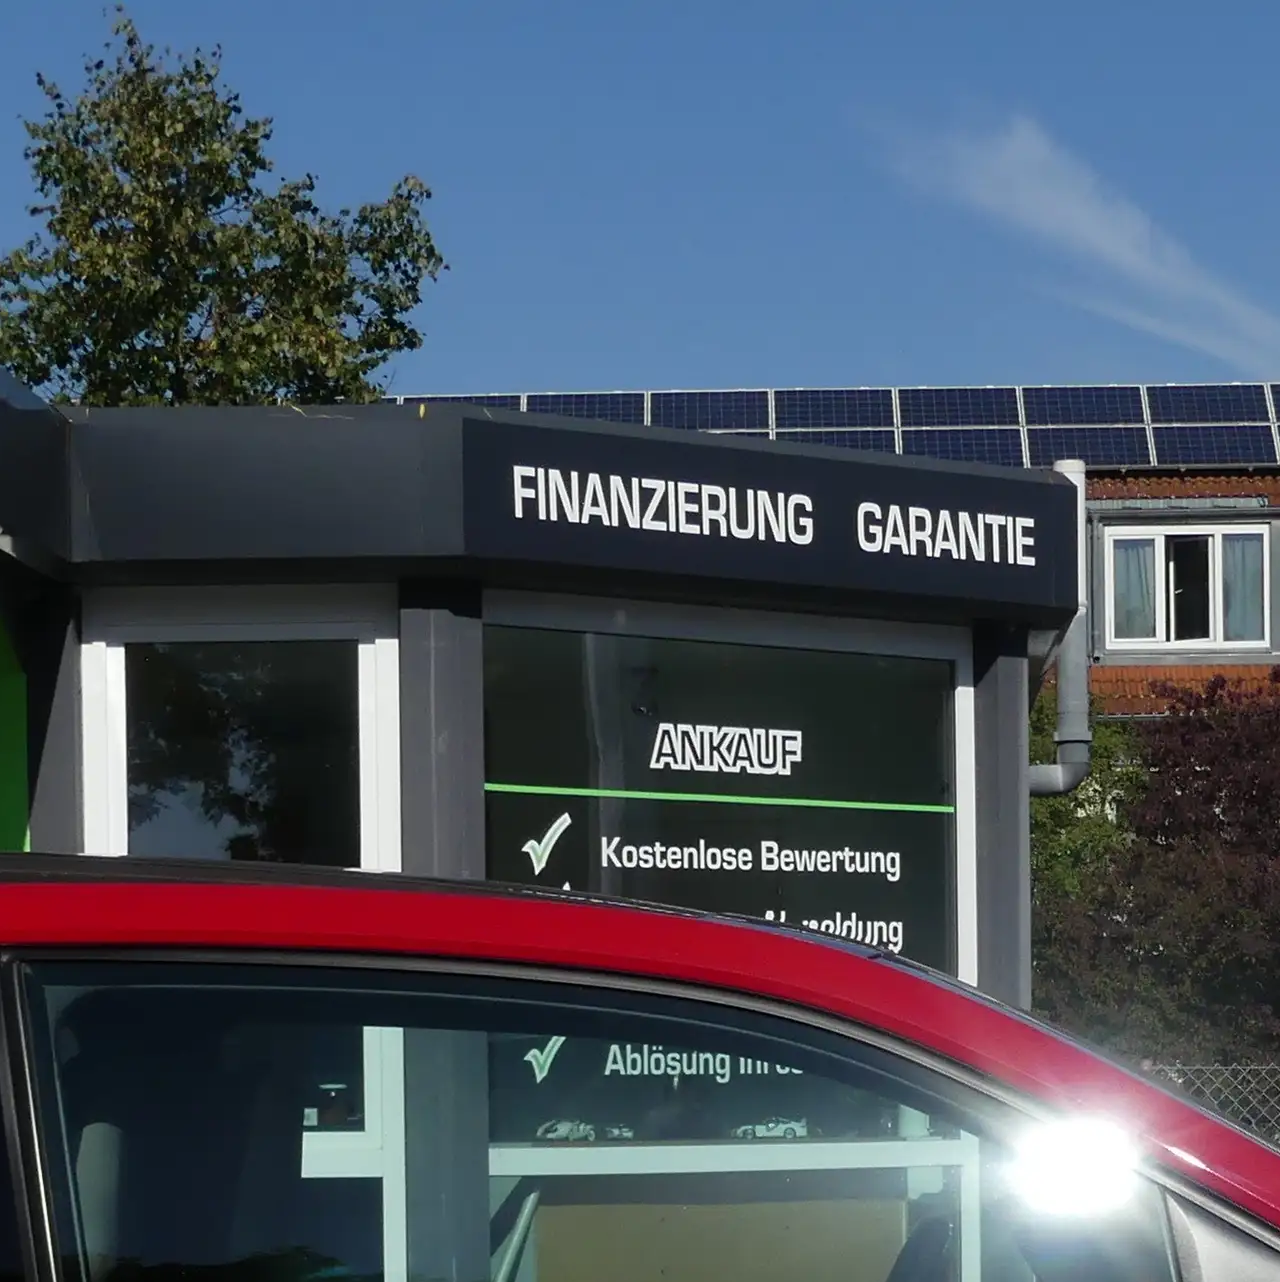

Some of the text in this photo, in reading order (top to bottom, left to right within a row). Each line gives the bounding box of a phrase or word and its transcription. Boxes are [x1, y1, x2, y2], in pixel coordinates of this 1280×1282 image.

[513, 465, 1036, 567] FINANZIERUNG GARANTIE
[650, 722, 802, 775] ANKAUF
[601, 837, 901, 882] Kostenlose Bewertung
[604, 1044, 731, 1083] Ablösung
